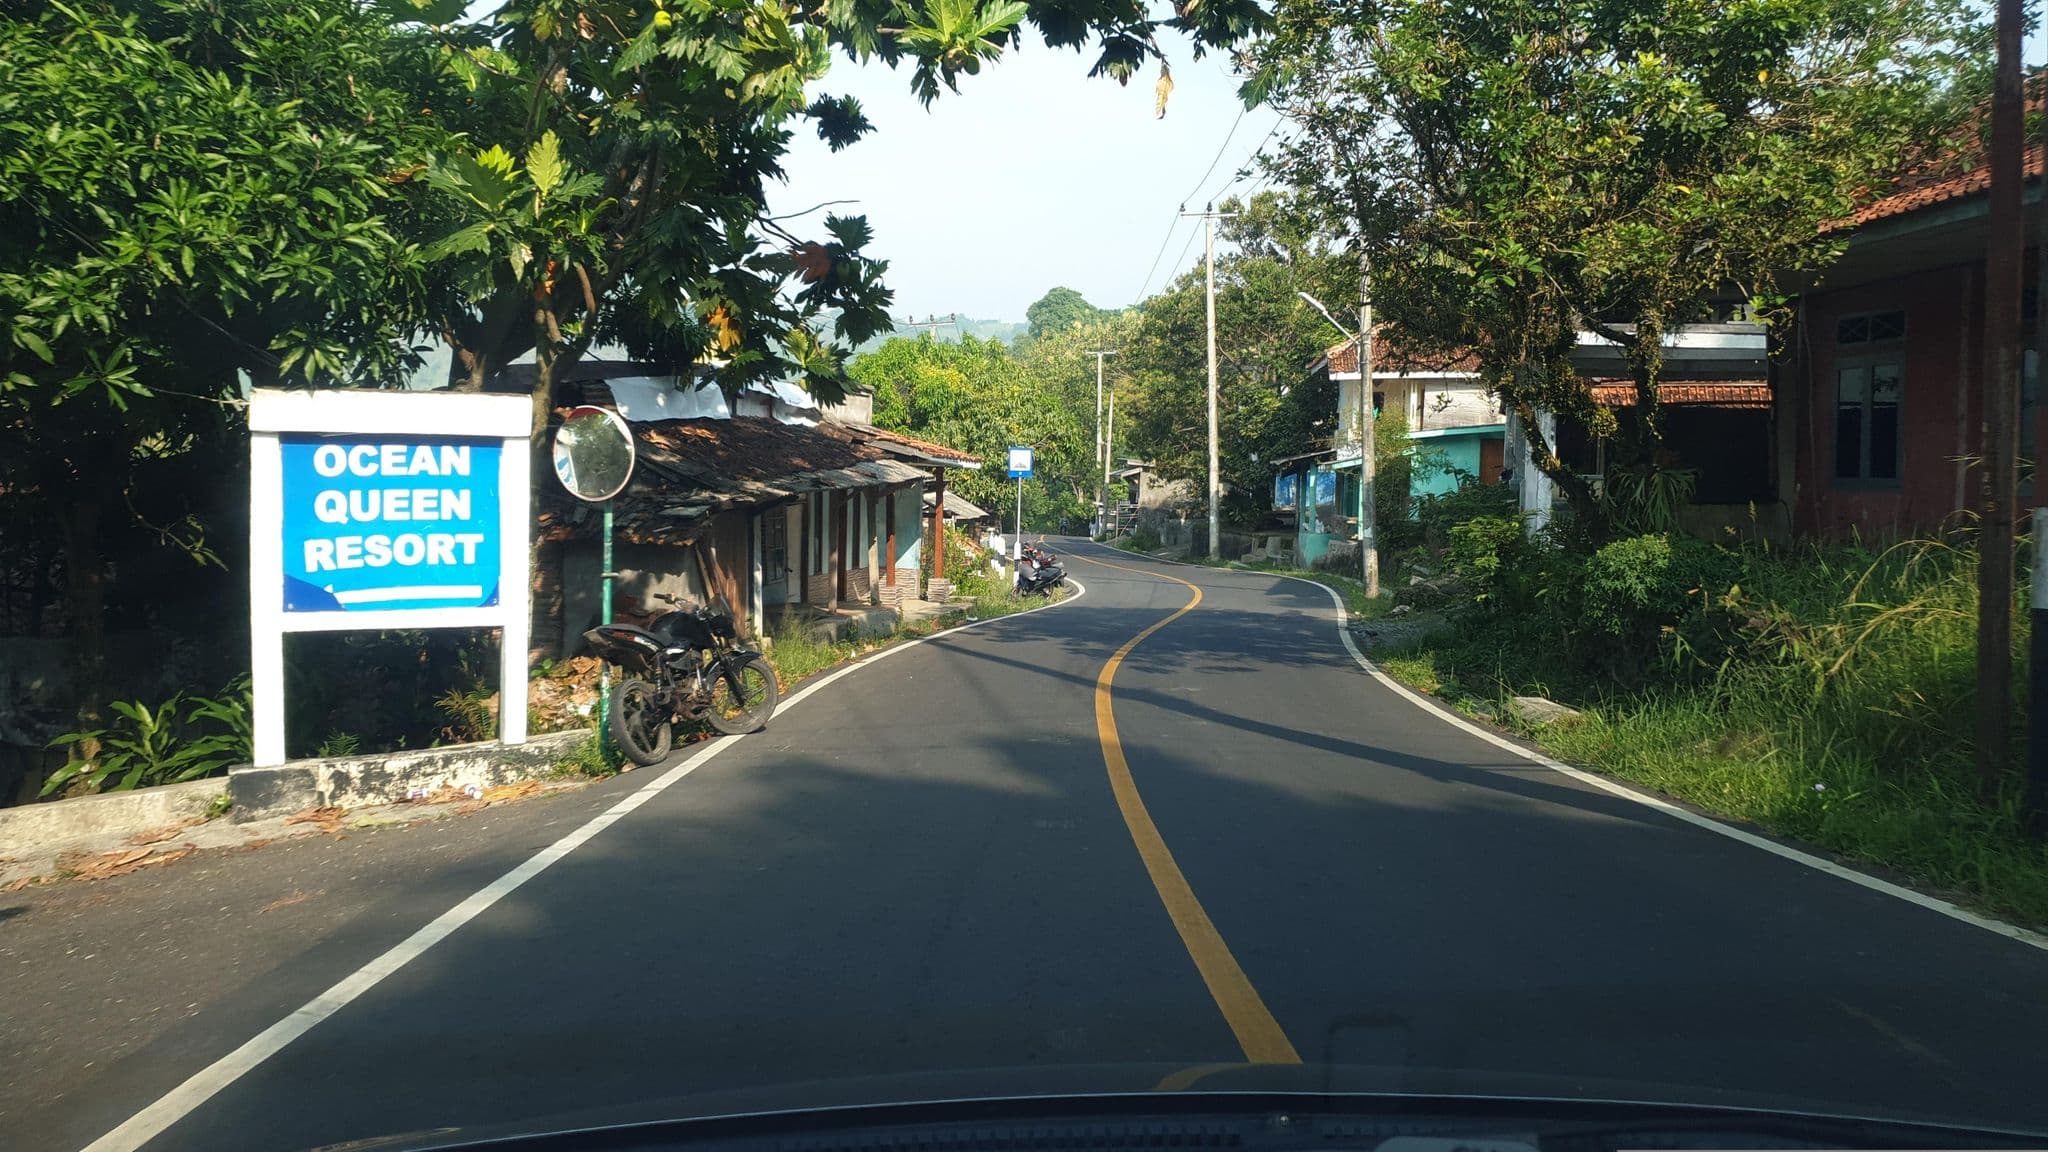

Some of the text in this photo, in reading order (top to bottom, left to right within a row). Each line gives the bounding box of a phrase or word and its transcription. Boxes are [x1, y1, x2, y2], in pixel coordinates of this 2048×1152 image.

[314, 444, 471, 477] OCEAN
[314, 489, 471, 524] QUEEN
[303, 533, 484, 573] RESORT
